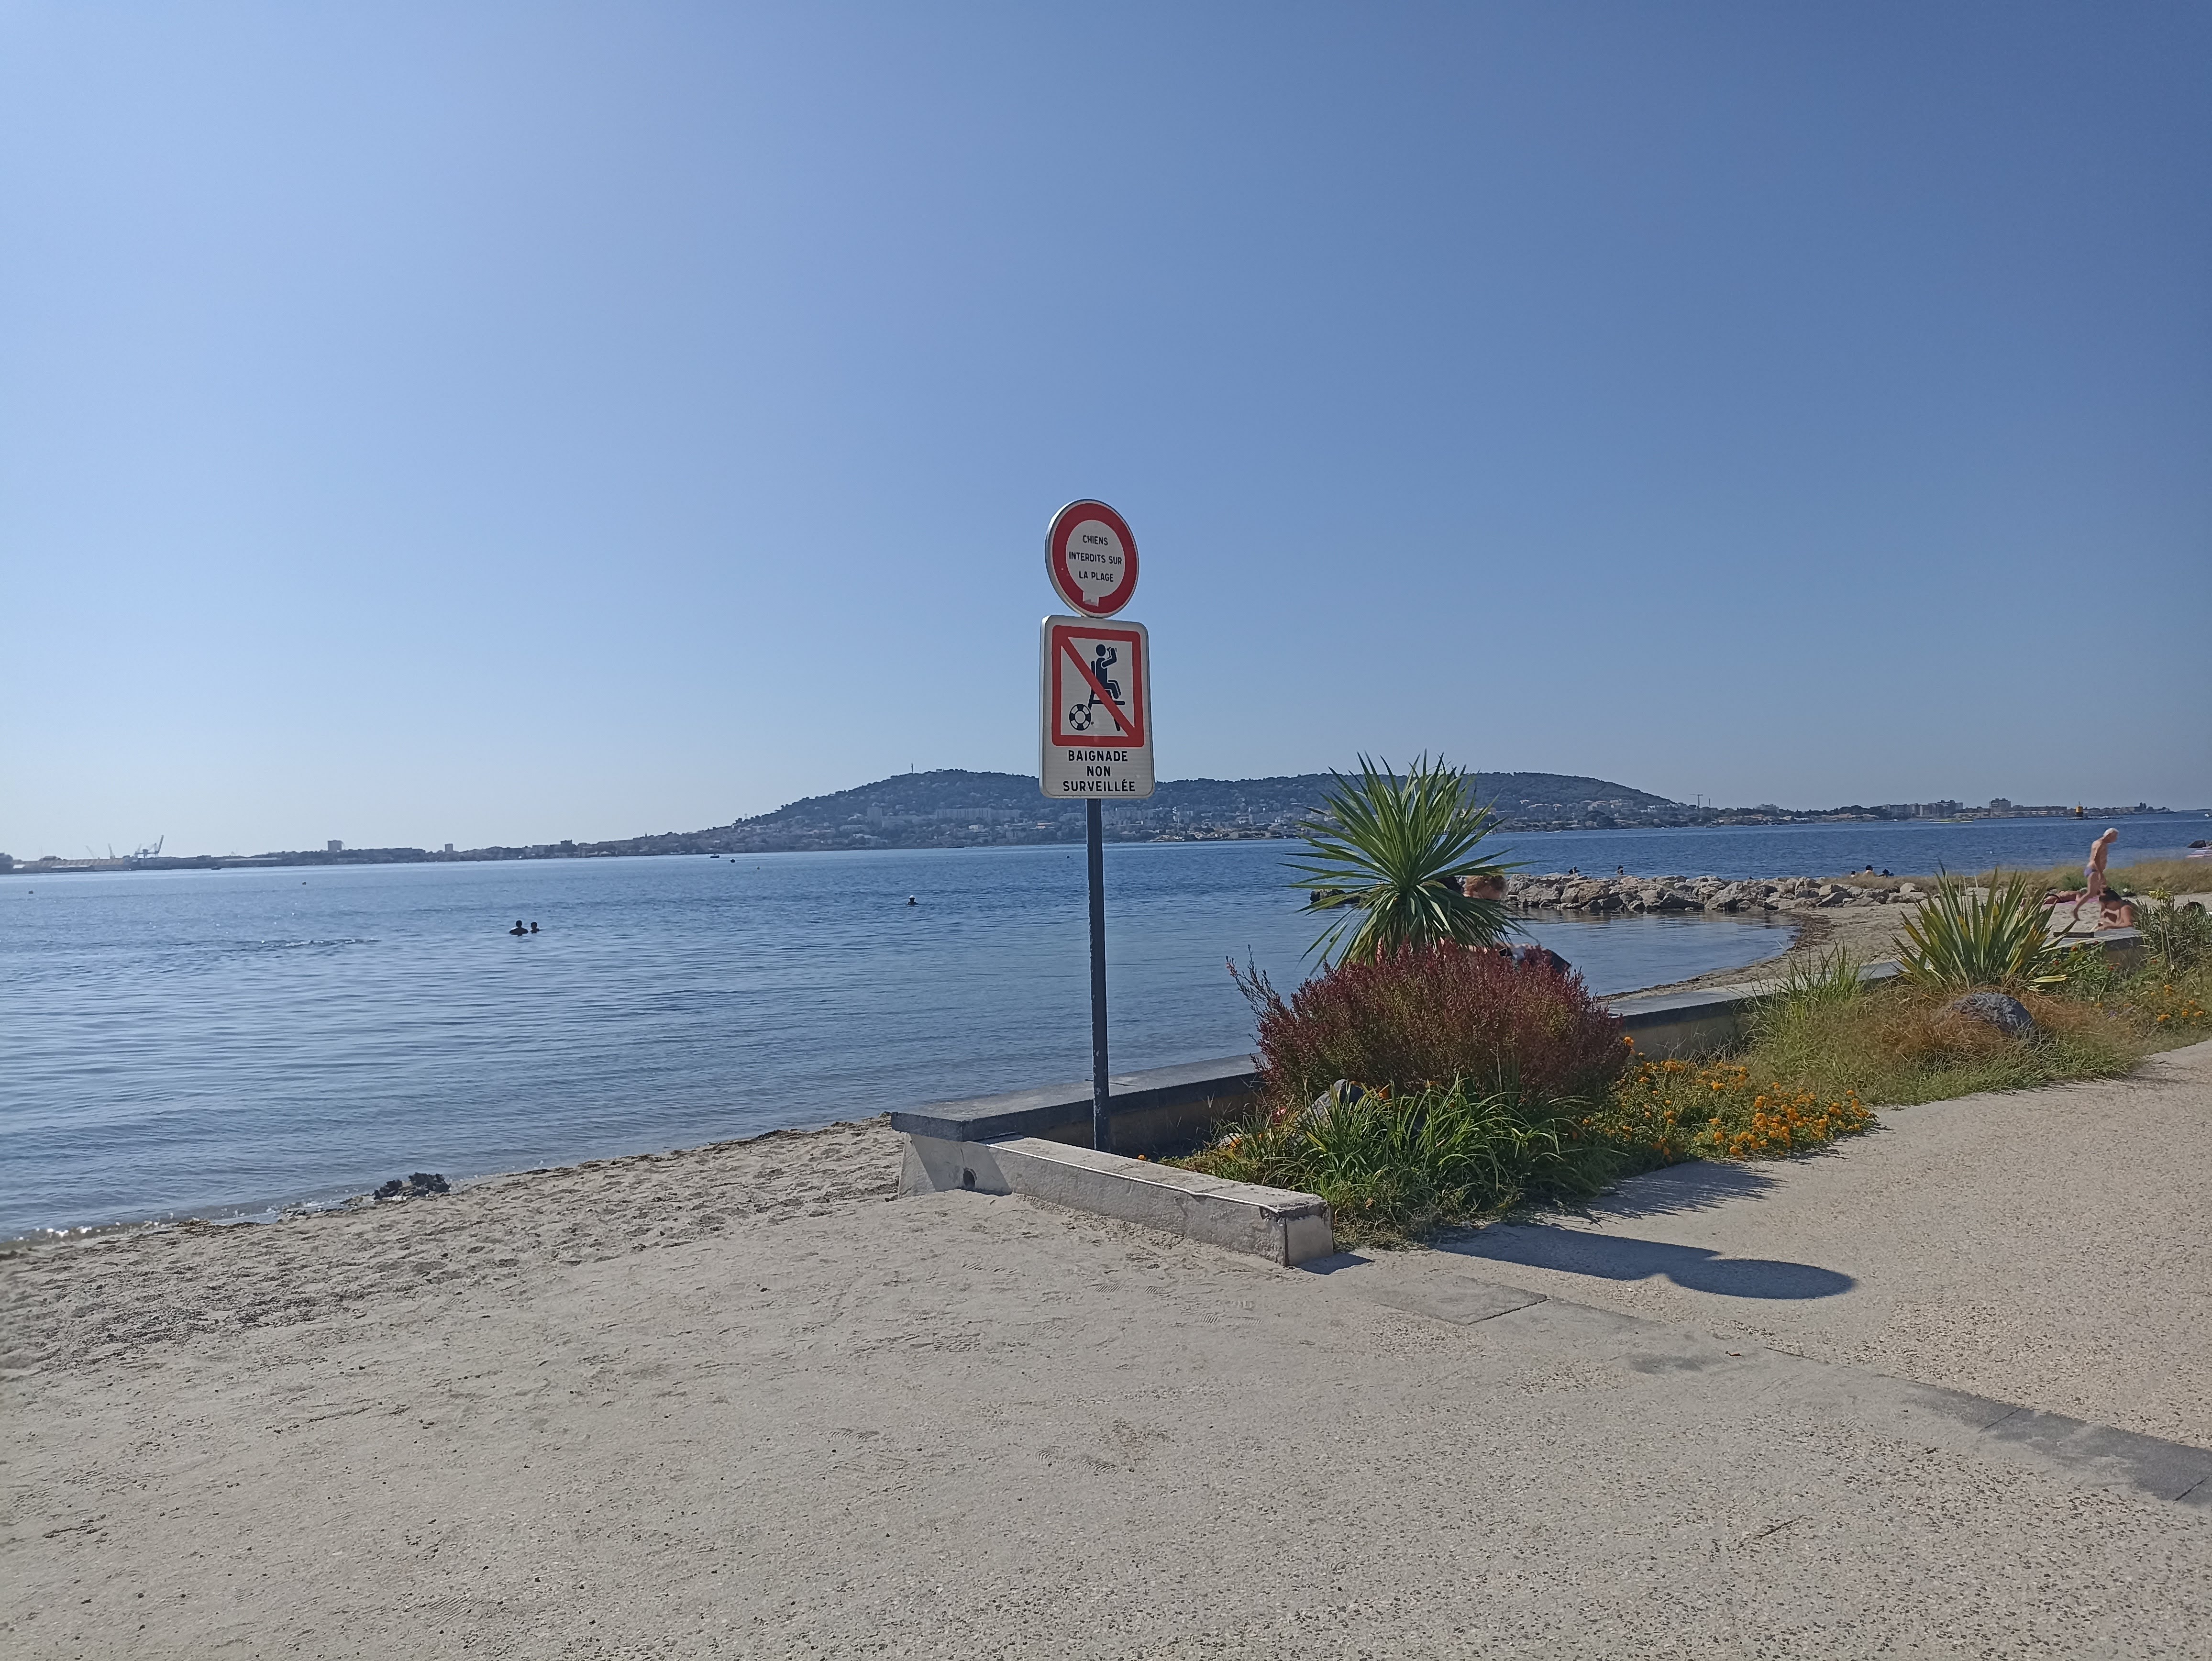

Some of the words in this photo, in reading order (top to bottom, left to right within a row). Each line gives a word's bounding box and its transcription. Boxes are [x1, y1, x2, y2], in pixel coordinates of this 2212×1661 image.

[1083, 535, 1108, 545] CHIENS
[1069, 551, 1106, 563] INTERDITS
[1109, 556, 1122, 565] SUR
[1079, 570, 1088, 579] LA
[1091, 571, 1114, 582] PLAGE
[1068, 750, 1128, 762] BAIGNADE
[1087, 765, 1111, 776] NON
[1063, 779, 1135, 792] SURVEILLÉE
